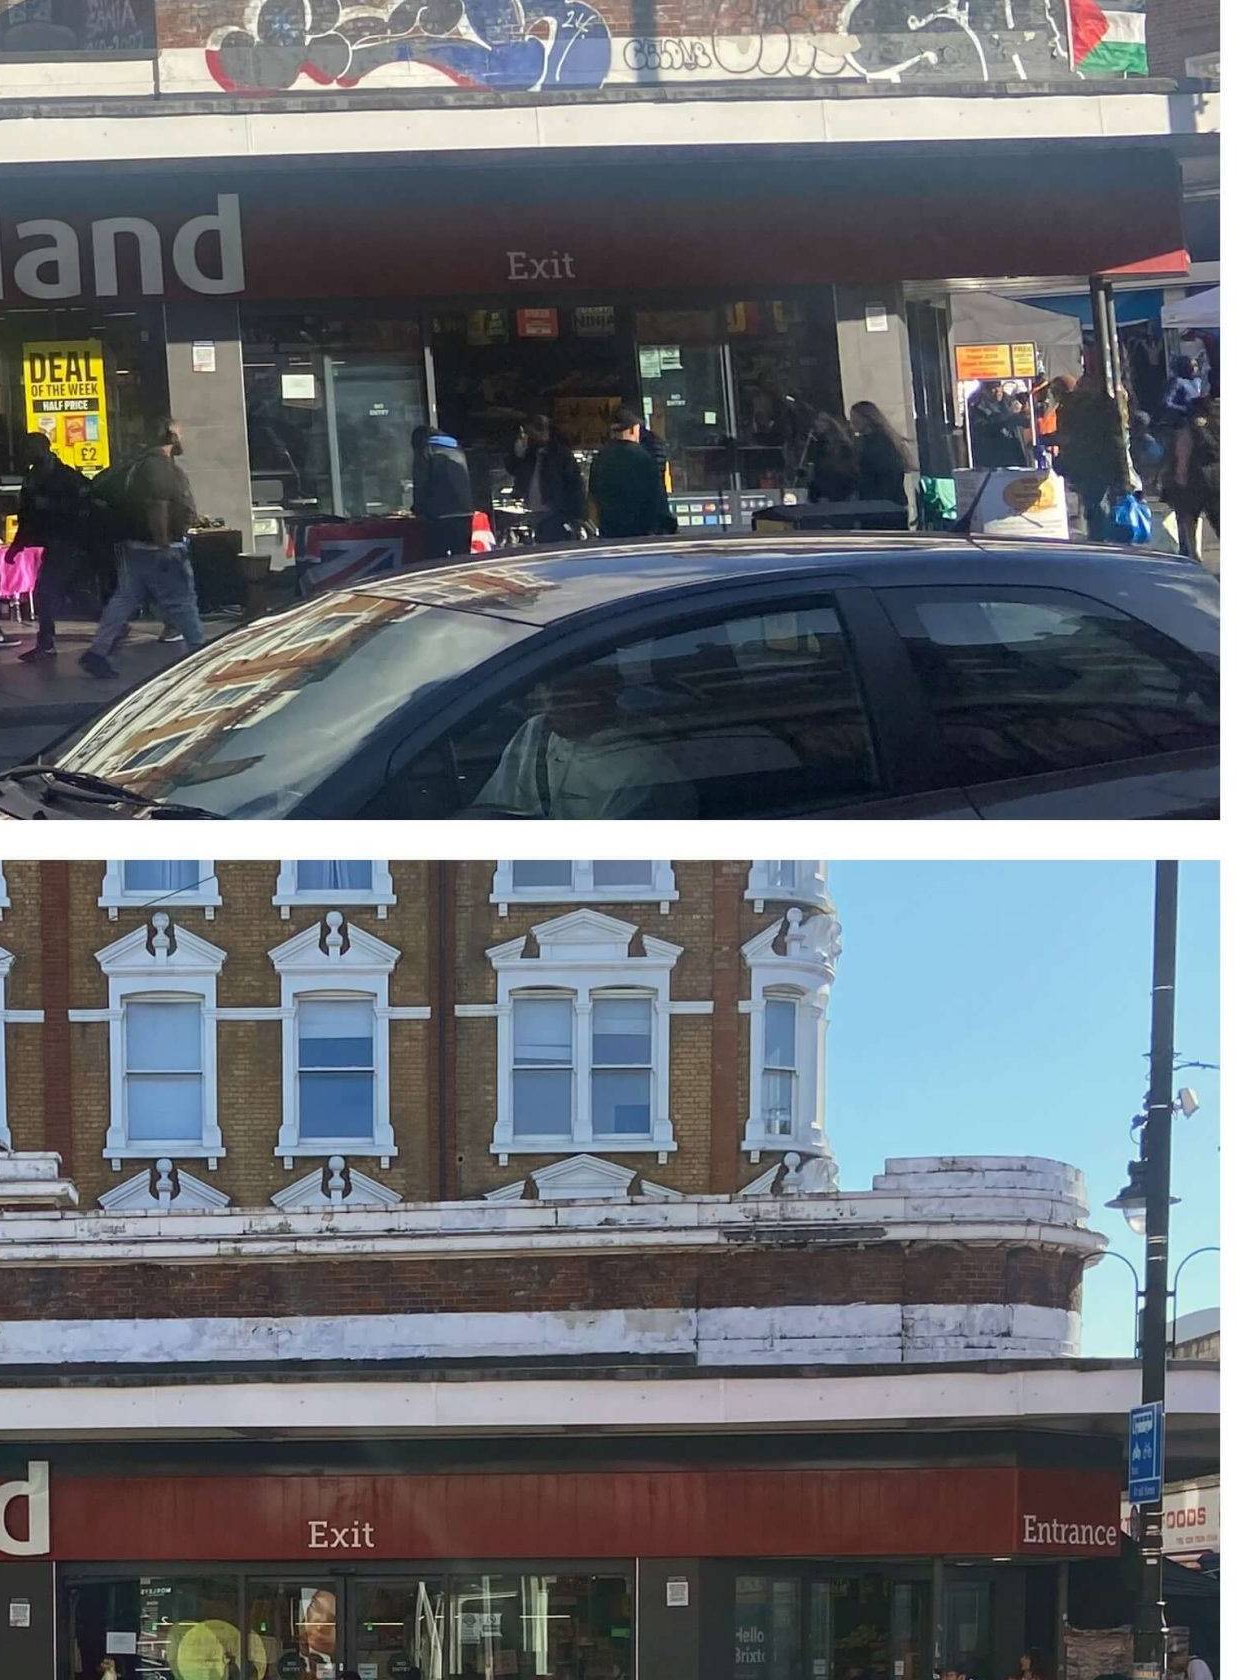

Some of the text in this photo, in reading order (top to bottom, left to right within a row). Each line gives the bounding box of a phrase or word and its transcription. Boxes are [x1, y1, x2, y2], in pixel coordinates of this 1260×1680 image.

[506, 251, 576, 281] Exit
[29, 351, 98, 384] DEAL
[31, 383, 99, 397] OF THE WEEK
[43, 400, 89, 411] HALF PRICE
[81, 447, 98, 462] £2
[1022, 1514, 1118, 1547] Entrance
[1166, 1506, 1207, 1530] OODS
[307, 1520, 375, 1549] Exit
